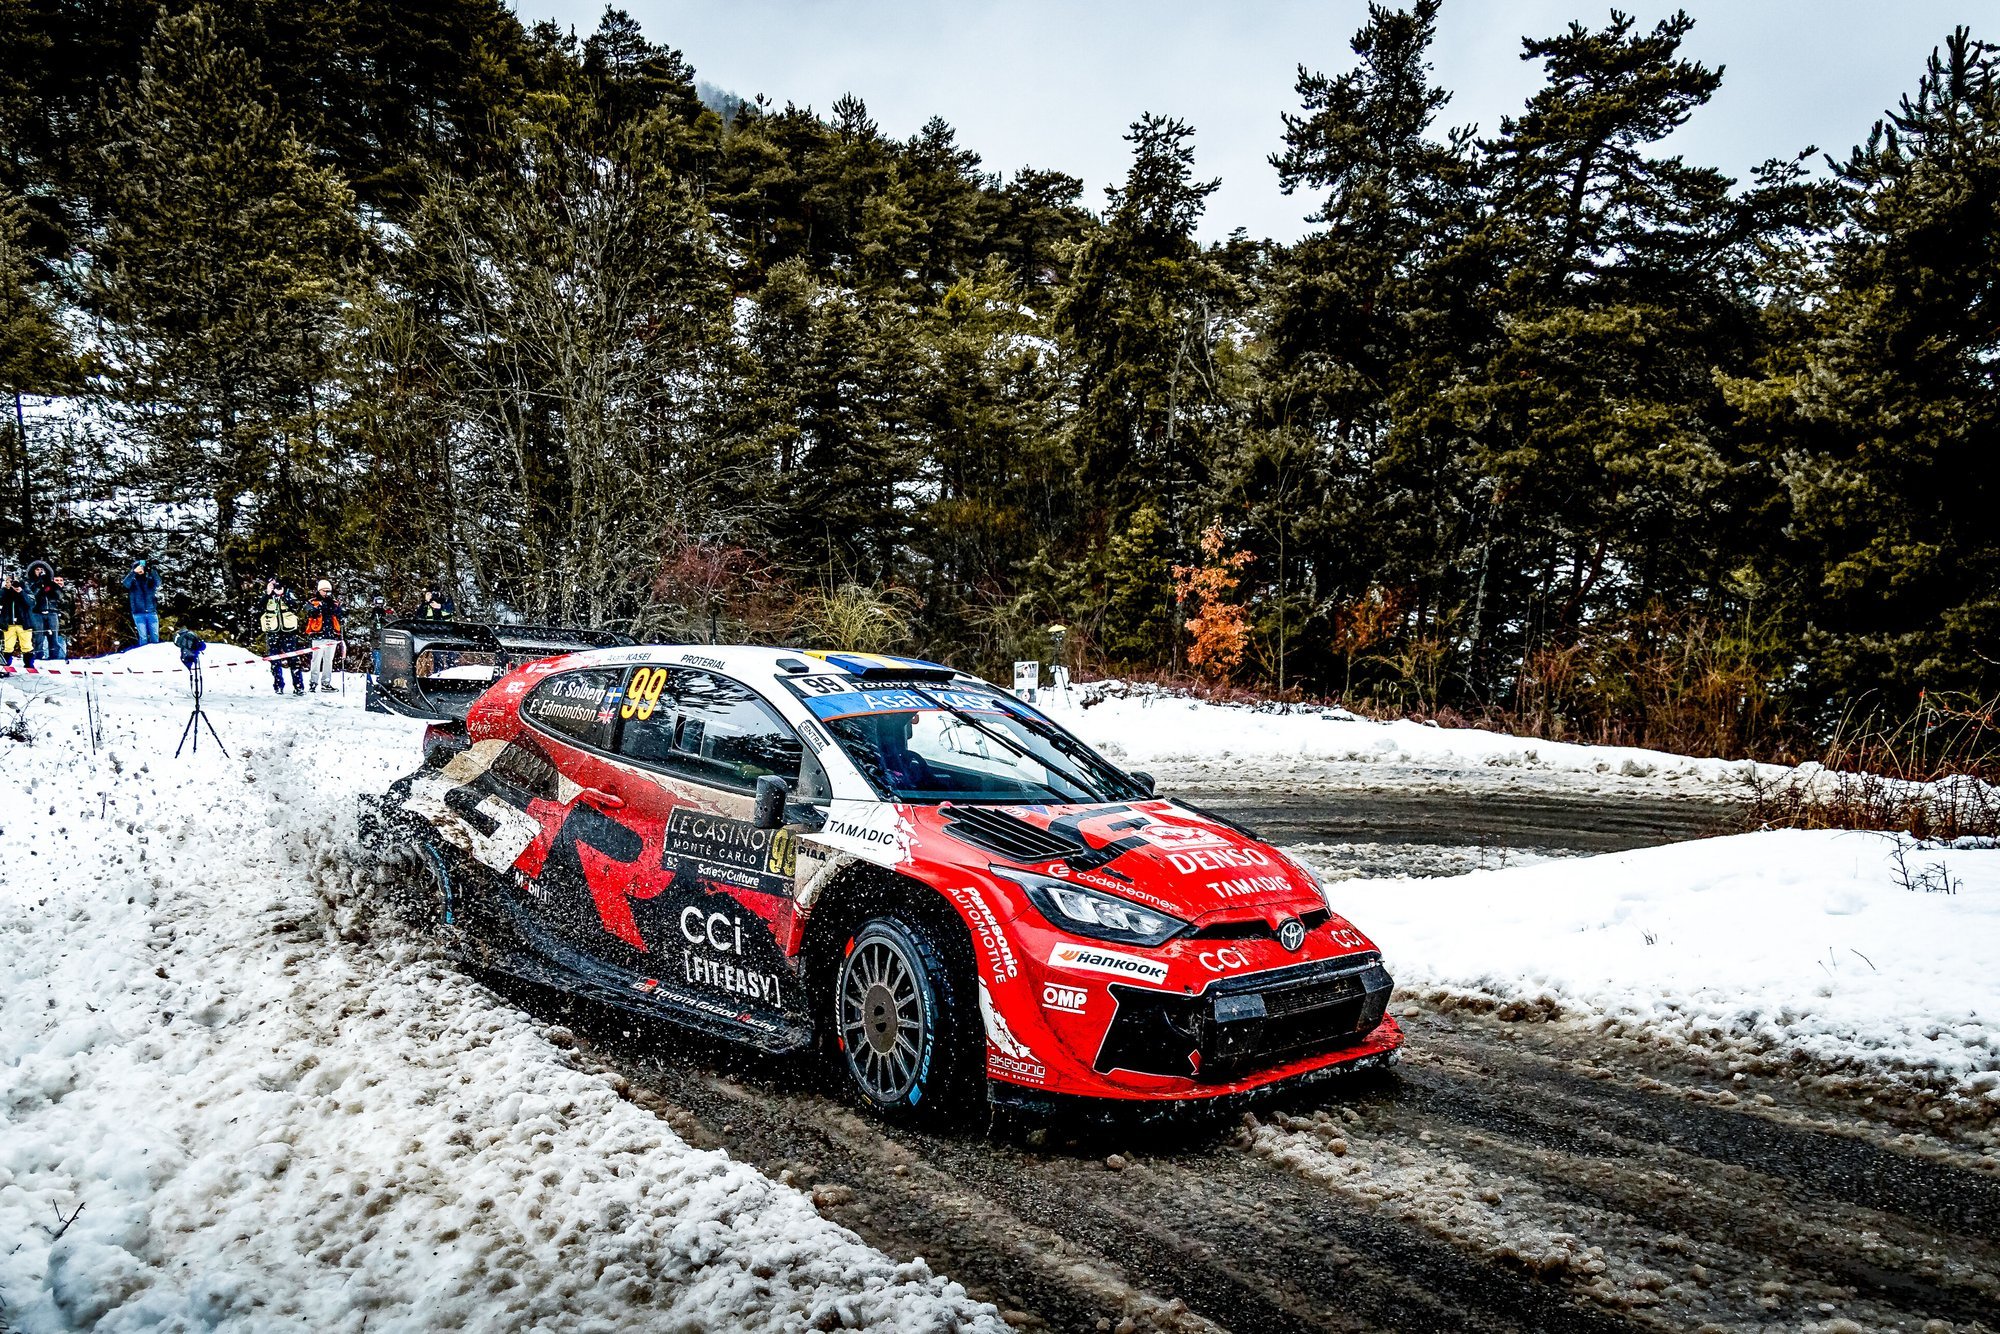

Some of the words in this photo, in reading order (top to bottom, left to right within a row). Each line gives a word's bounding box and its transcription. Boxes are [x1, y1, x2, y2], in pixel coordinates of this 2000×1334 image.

[626, 653, 652, 661] KASEI
[680, 654, 726, 671] PROTERIAL
[565, 681, 606, 705] Solberg
[621, 667, 667, 721] 99
[803, 676, 845, 694] 99
[529, 699, 538, 715] E.
[538, 699, 597, 723] Edmondson
[801, 722, 824, 752] CENTRAL
[671, 813, 688, 835] LE
[692, 818, 766, 851] CASINO
[829, 820, 895, 846] TAMADIC
[673, 838, 712, 856] MONTE
[718, 848, 757, 865] CARLO
[769, 828, 797, 877] 99
[798, 844, 827, 862] PIAA
[1166, 849, 1269, 876] DENSO
[697, 863, 760, 886] SafetyCulture
[1077, 871, 1182, 911] codebeamer
[1206, 876, 1293, 899] TAMADIC
[947, 888, 1007, 984] AUTOMOTIVE
[961, 887, 1018, 978] Panasonic
[653, 987, 696, 1006] TOYOTA
[695, 1001, 738, 1019] GAZOO
[736, 1011, 777, 1032] Racing
[1042, 986, 1088, 1009] OMP
[988, 1054, 1046, 1076] akebono
[1012, 1074, 1045, 1085] EXPERTS
